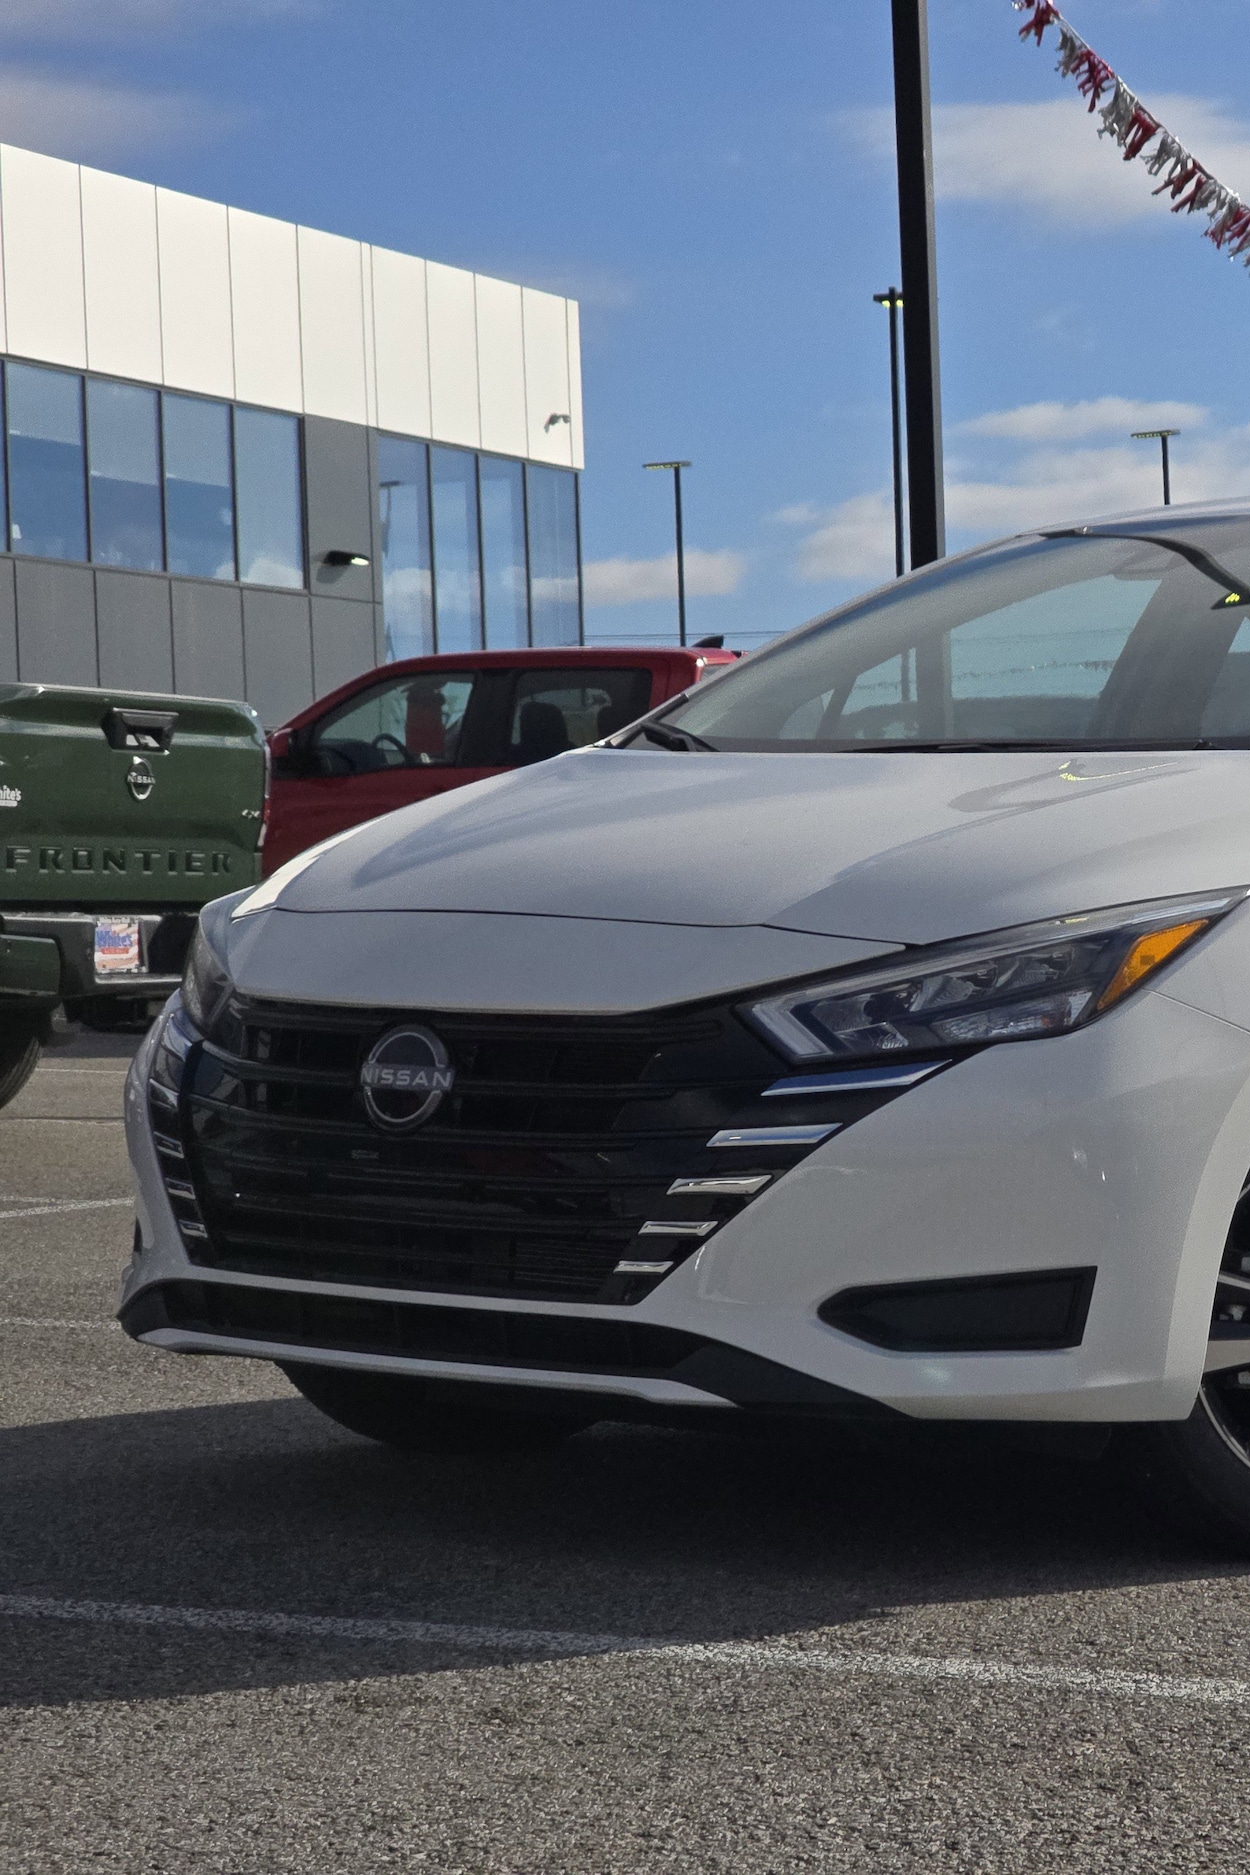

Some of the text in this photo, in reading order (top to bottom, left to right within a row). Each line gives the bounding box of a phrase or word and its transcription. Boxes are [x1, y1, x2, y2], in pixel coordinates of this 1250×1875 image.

[127, 773, 156, 784] NISSAN
[6, 846, 232, 876] FRONTIER
[361, 1067, 452, 1088] NISSAN
